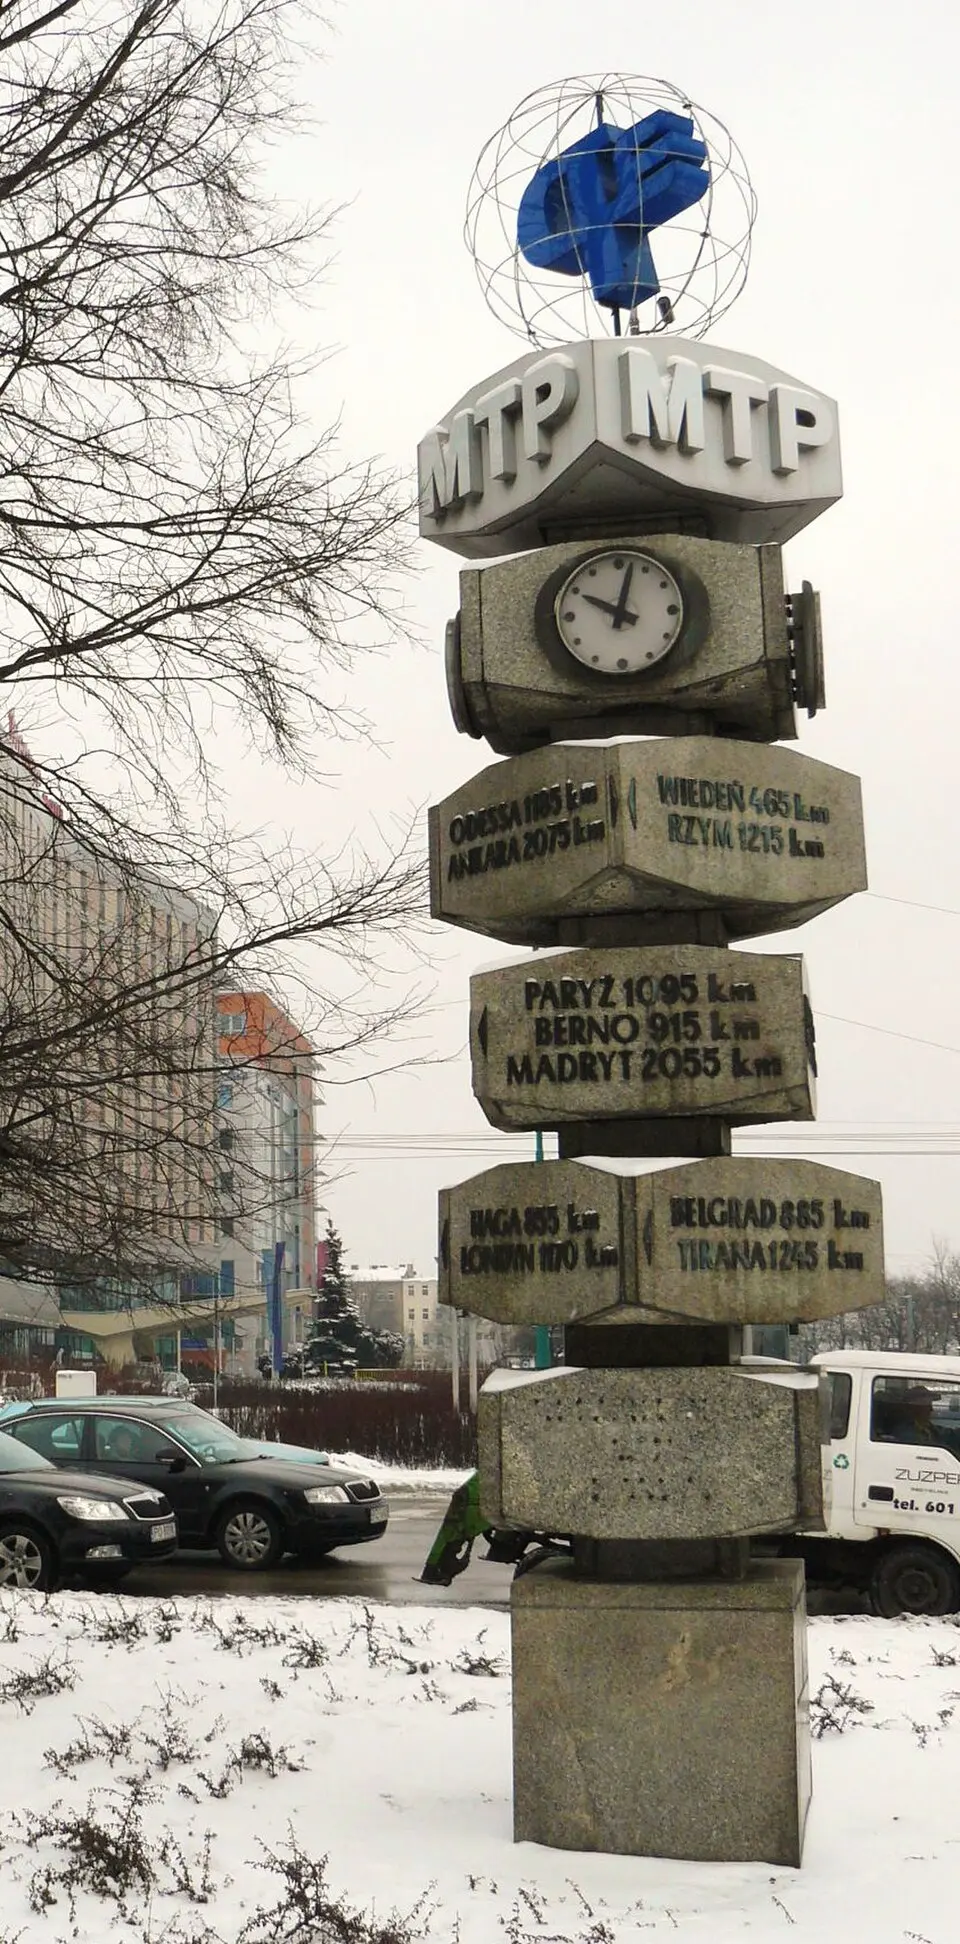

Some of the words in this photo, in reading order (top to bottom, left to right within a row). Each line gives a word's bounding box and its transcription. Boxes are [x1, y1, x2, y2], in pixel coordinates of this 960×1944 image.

[618, 346, 834, 474] MTP
[418, 352, 580, 520] MTP
[450, 800, 523, 845] ODESSA
[566, 778, 598, 812] km
[748, 786, 791, 818] 465
[793, 792, 830, 824] km
[573, 817, 605, 847] km
[668, 813, 733, 849] RZYM
[739, 821, 784, 855] 1215
[788, 827, 825, 858] km
[623, 973, 700, 1007] 1095
[707, 972, 757, 1003] km
[535, 1013, 640, 1046] BERNO
[647, 1010, 702, 1042] 915
[710, 1009, 761, 1041] km
[507, 1051, 633, 1085] MADRYT
[641, 1046, 721, 1081] 2055
[731, 1047, 783, 1079] km
[567, 1202, 600, 1234] km
[669, 1196, 777, 1230] BELGRAD
[779, 1199, 825, 1231] 885
[833, 1198, 870, 1230] km
[585, 1237, 619, 1270] km
[677, 1238, 767, 1272] TIRANA
[768, 1239, 819, 1272] 1245
[827, 1239, 863, 1271] km
[893, 1498, 919, 1511] tel.
[925, 1501, 955, 1515] 601
